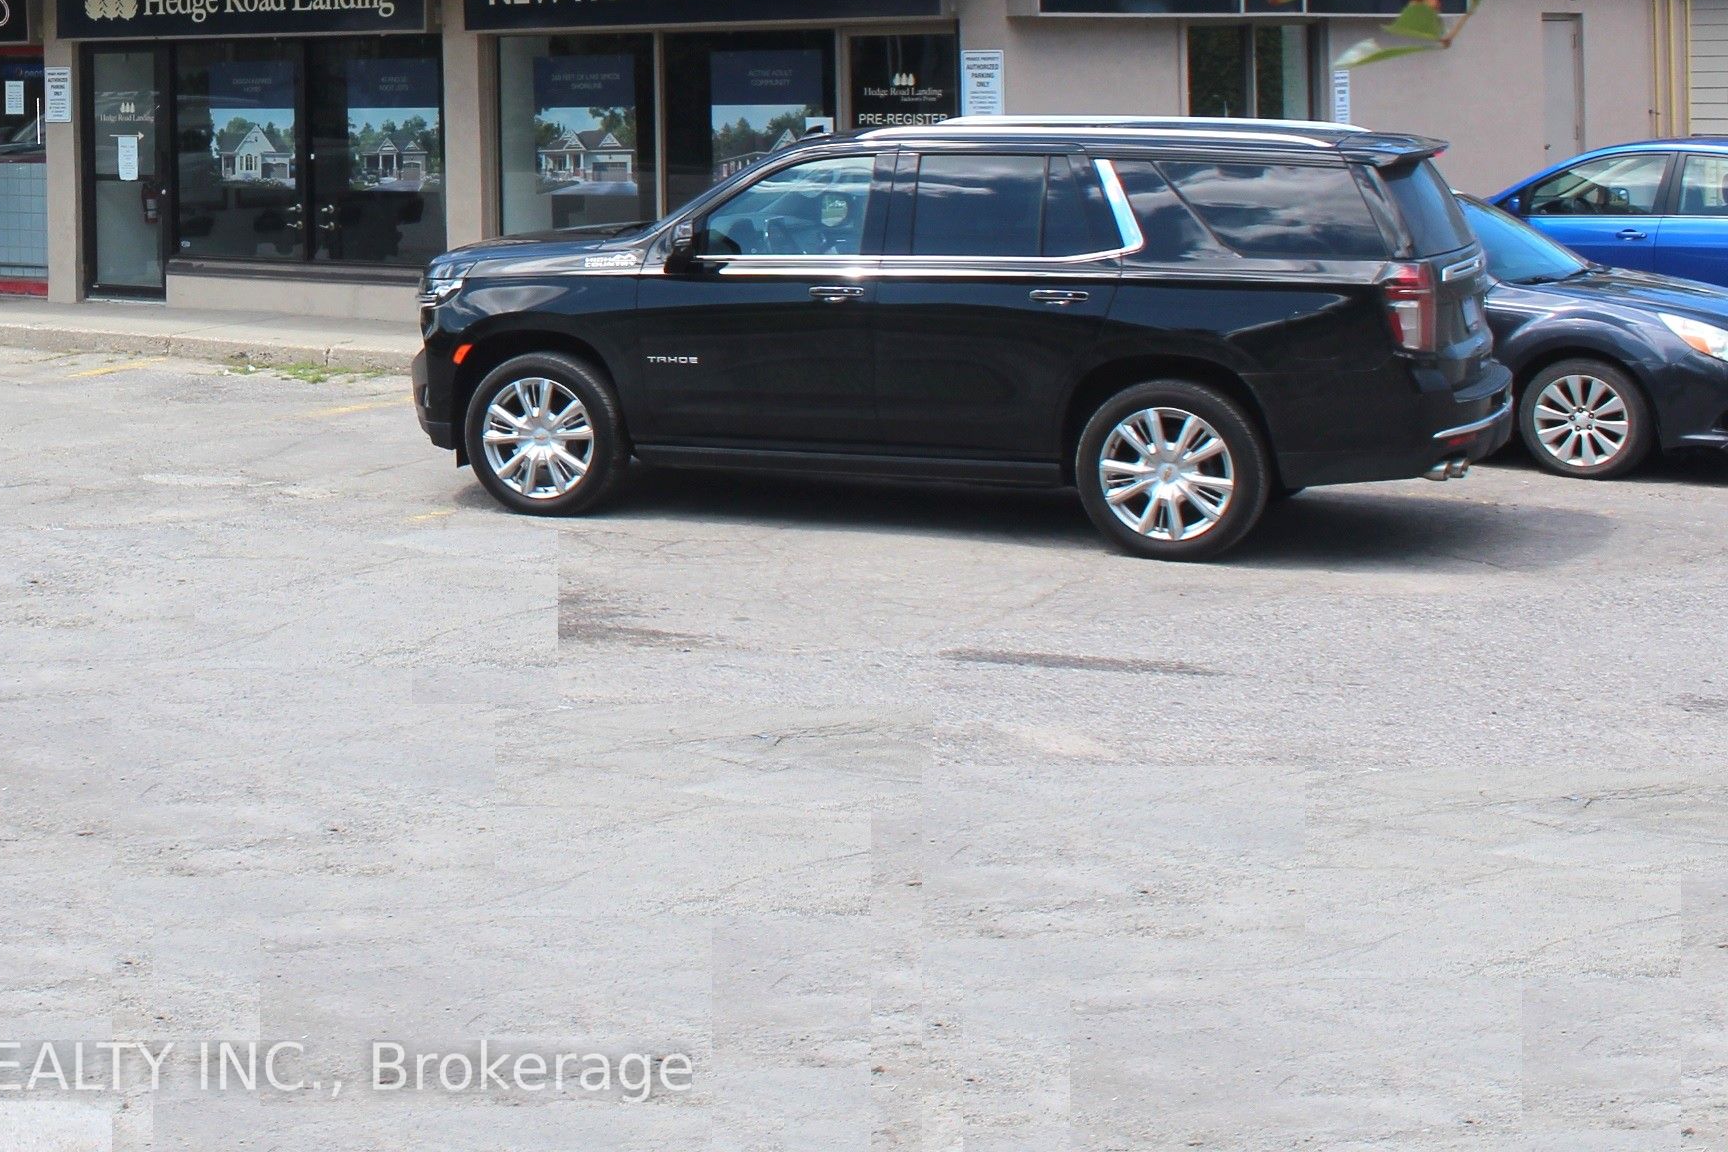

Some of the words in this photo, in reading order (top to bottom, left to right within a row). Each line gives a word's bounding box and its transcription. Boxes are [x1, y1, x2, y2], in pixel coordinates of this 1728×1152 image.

[864, 87, 888, 98] Hedge
[890, 87, 910, 96] Road
[911, 87, 943, 98] Landing
[132, 114, 154, 122] Landing
[647, 356, 699, 364] TAHOE
